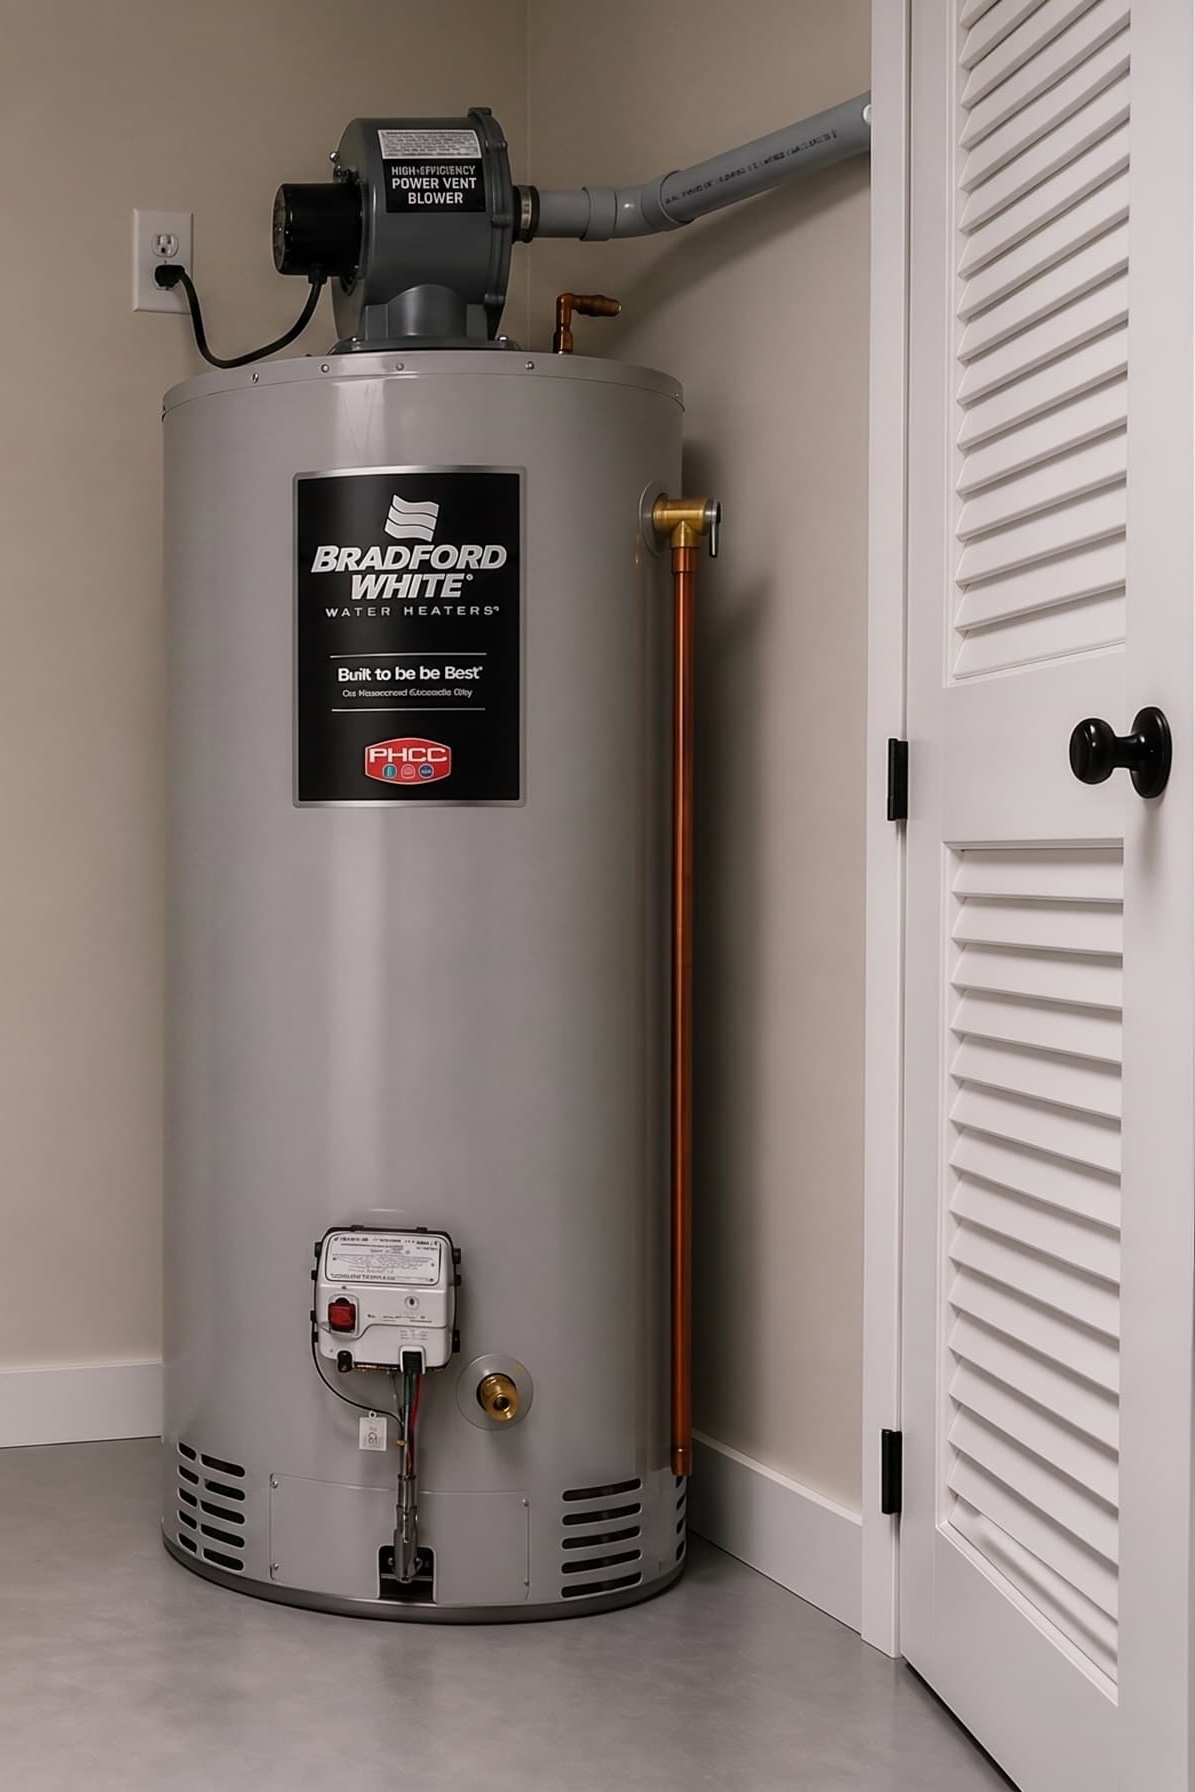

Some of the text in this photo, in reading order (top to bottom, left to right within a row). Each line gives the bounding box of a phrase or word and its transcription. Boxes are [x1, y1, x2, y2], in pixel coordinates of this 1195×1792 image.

[392, 177, 477, 189] POWER VENT
[408, 192, 463, 204] BLOWER
[311, 545, 507, 573] BRADFORD
[325, 606, 391, 618] WATER
[375, 667, 392, 681] to
[395, 666, 416, 681] be
[419, 665, 441, 680] be
[369, 747, 448, 763] PHCC
